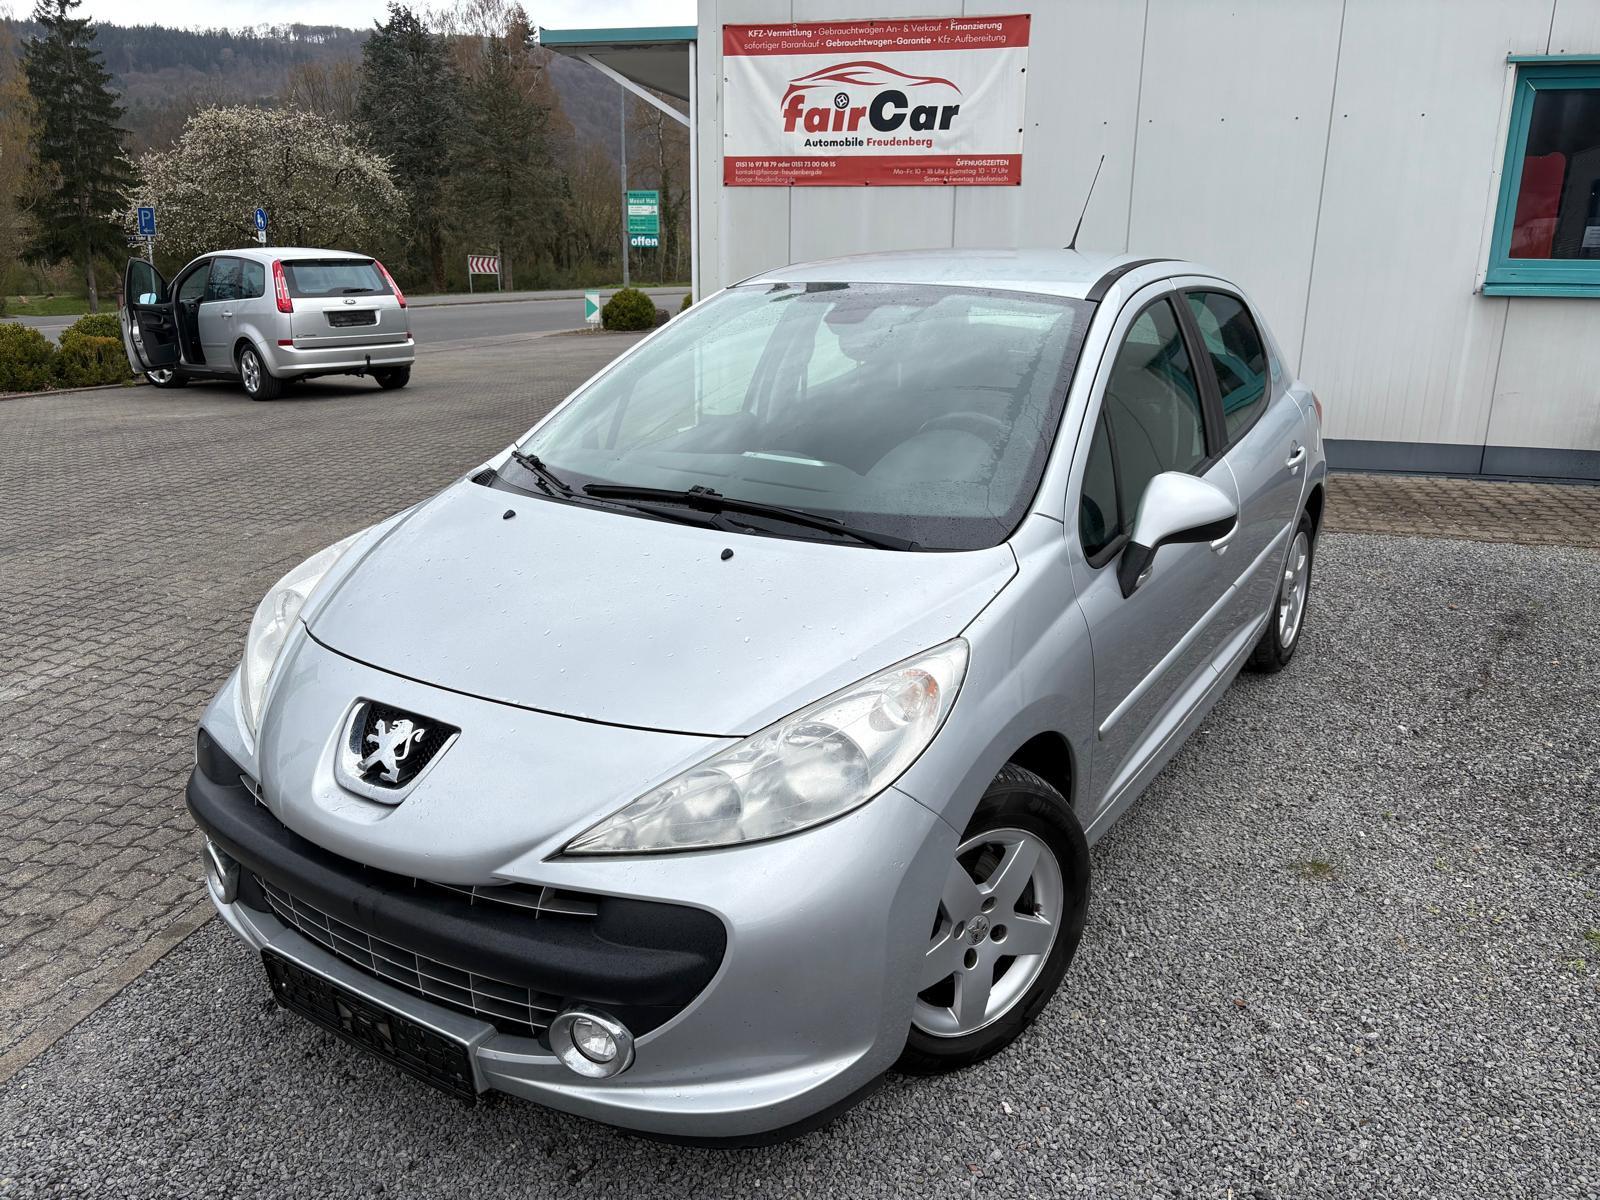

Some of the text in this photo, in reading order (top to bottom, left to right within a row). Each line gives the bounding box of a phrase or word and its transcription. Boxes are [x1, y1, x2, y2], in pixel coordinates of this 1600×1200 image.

[748, 22, 1003, 38] KFZ-Vermittlung Gebrauchtwagen An- & Verkauf Finanzierung
[744, 34, 1007, 50] sofortiger Barankauf Gebrauchtwagen-Garantie Kfz-Aufbereitung
[783, 89, 960, 133] fairCar
[804, 136, 933, 148] Automobile Freudenberg
[778, 160, 790, 168] oder
[141, 210, 150, 226] P
[631, 236, 658, 247] offen
